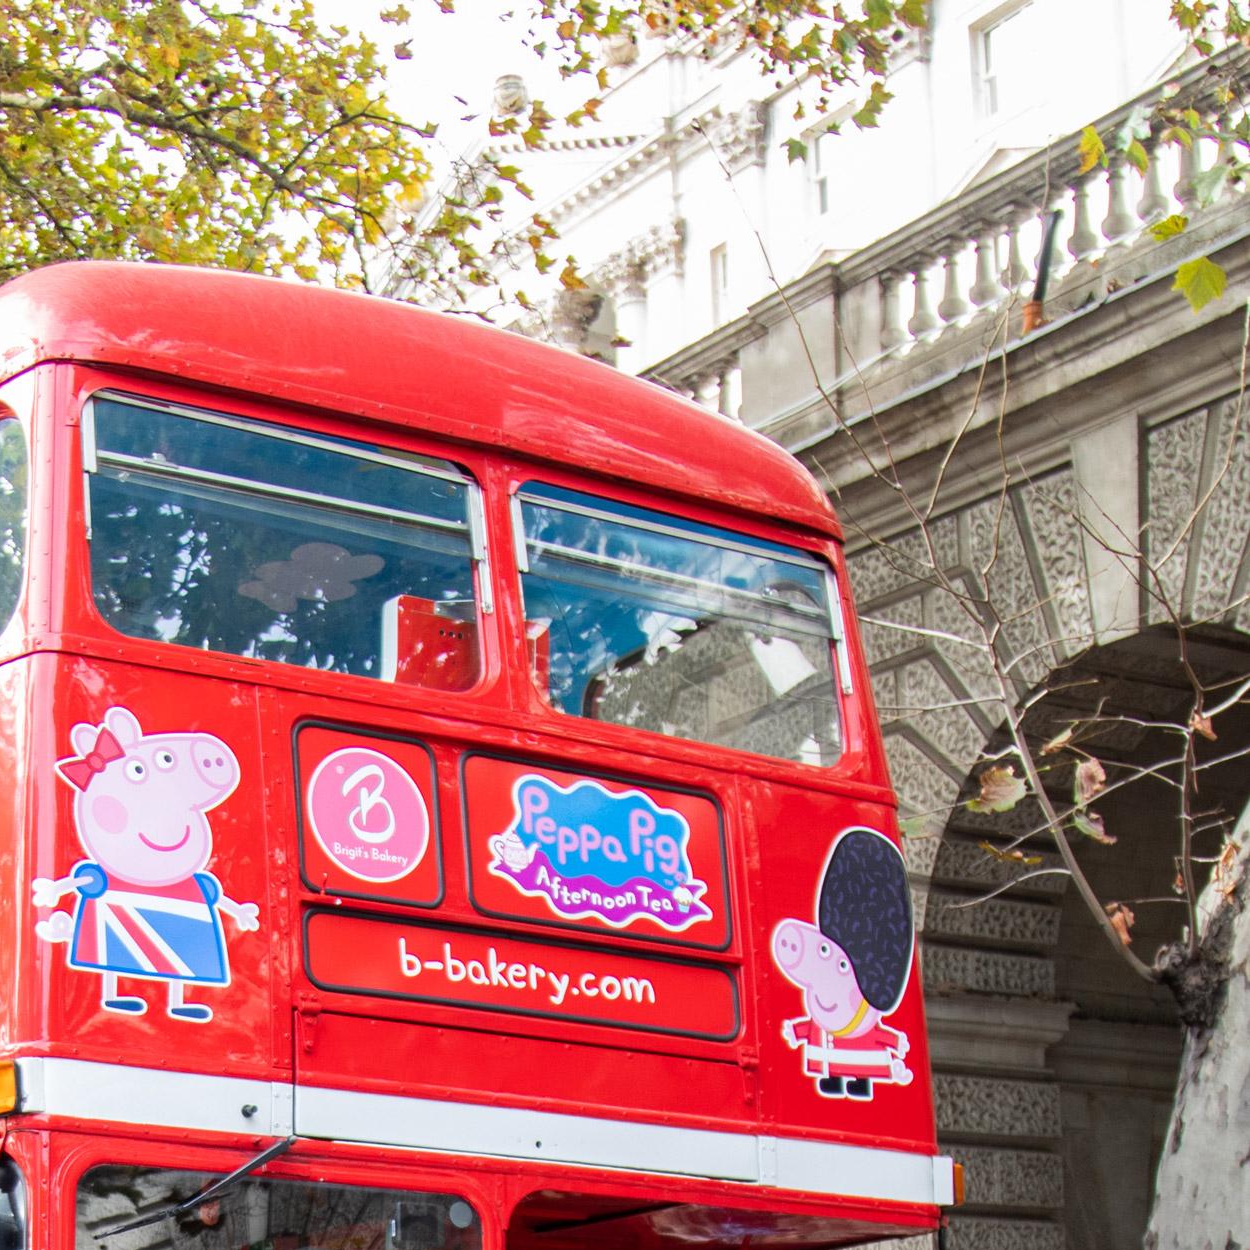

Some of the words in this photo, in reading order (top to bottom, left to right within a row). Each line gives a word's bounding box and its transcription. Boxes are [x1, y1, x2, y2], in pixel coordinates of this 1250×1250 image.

[342, 764, 395, 843] B
[523, 786, 627, 865] Peppa
[629, 808, 680, 874] Pig
[334, 842, 369, 860] Brigit's
[372, 847, 408, 867] Bakery
[536, 865, 636, 909] Afternoon
[636, 886, 673, 911] Tea
[398, 937, 655, 1004] b-bakery.com
